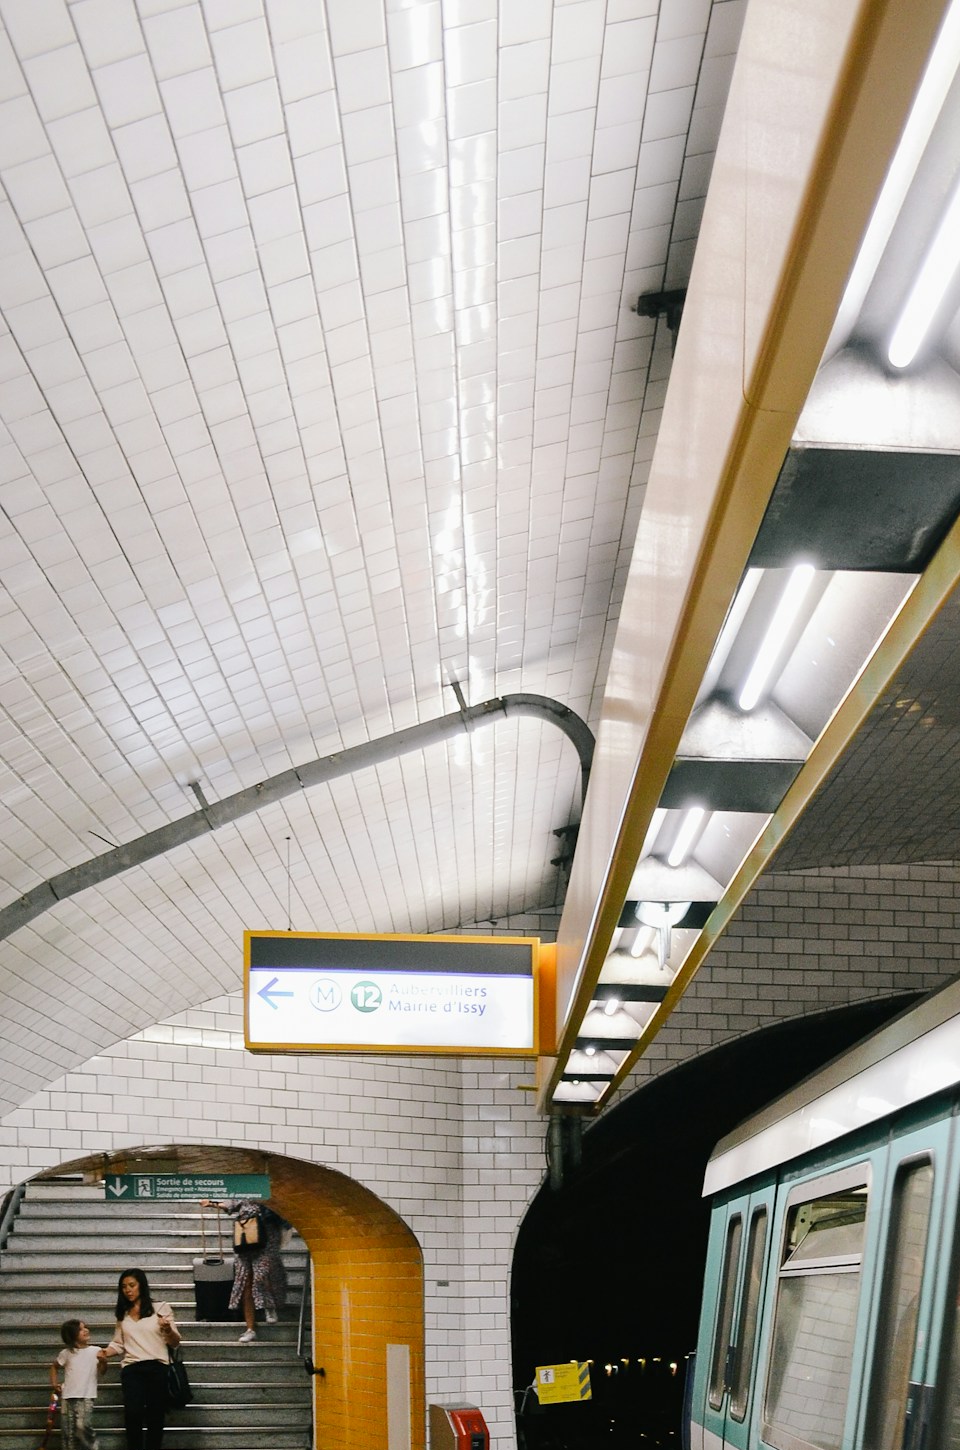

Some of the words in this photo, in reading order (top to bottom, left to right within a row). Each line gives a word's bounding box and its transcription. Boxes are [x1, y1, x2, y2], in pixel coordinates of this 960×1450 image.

[316, 986, 334, 1004] M
[353, 985, 381, 1008] 12
[389, 983, 487, 997] Aubervilliers
[388, 1000, 437, 1012] Mairie
[156, 1178, 181, 1186] Sortie
[182, 1178, 193, 1186] de
